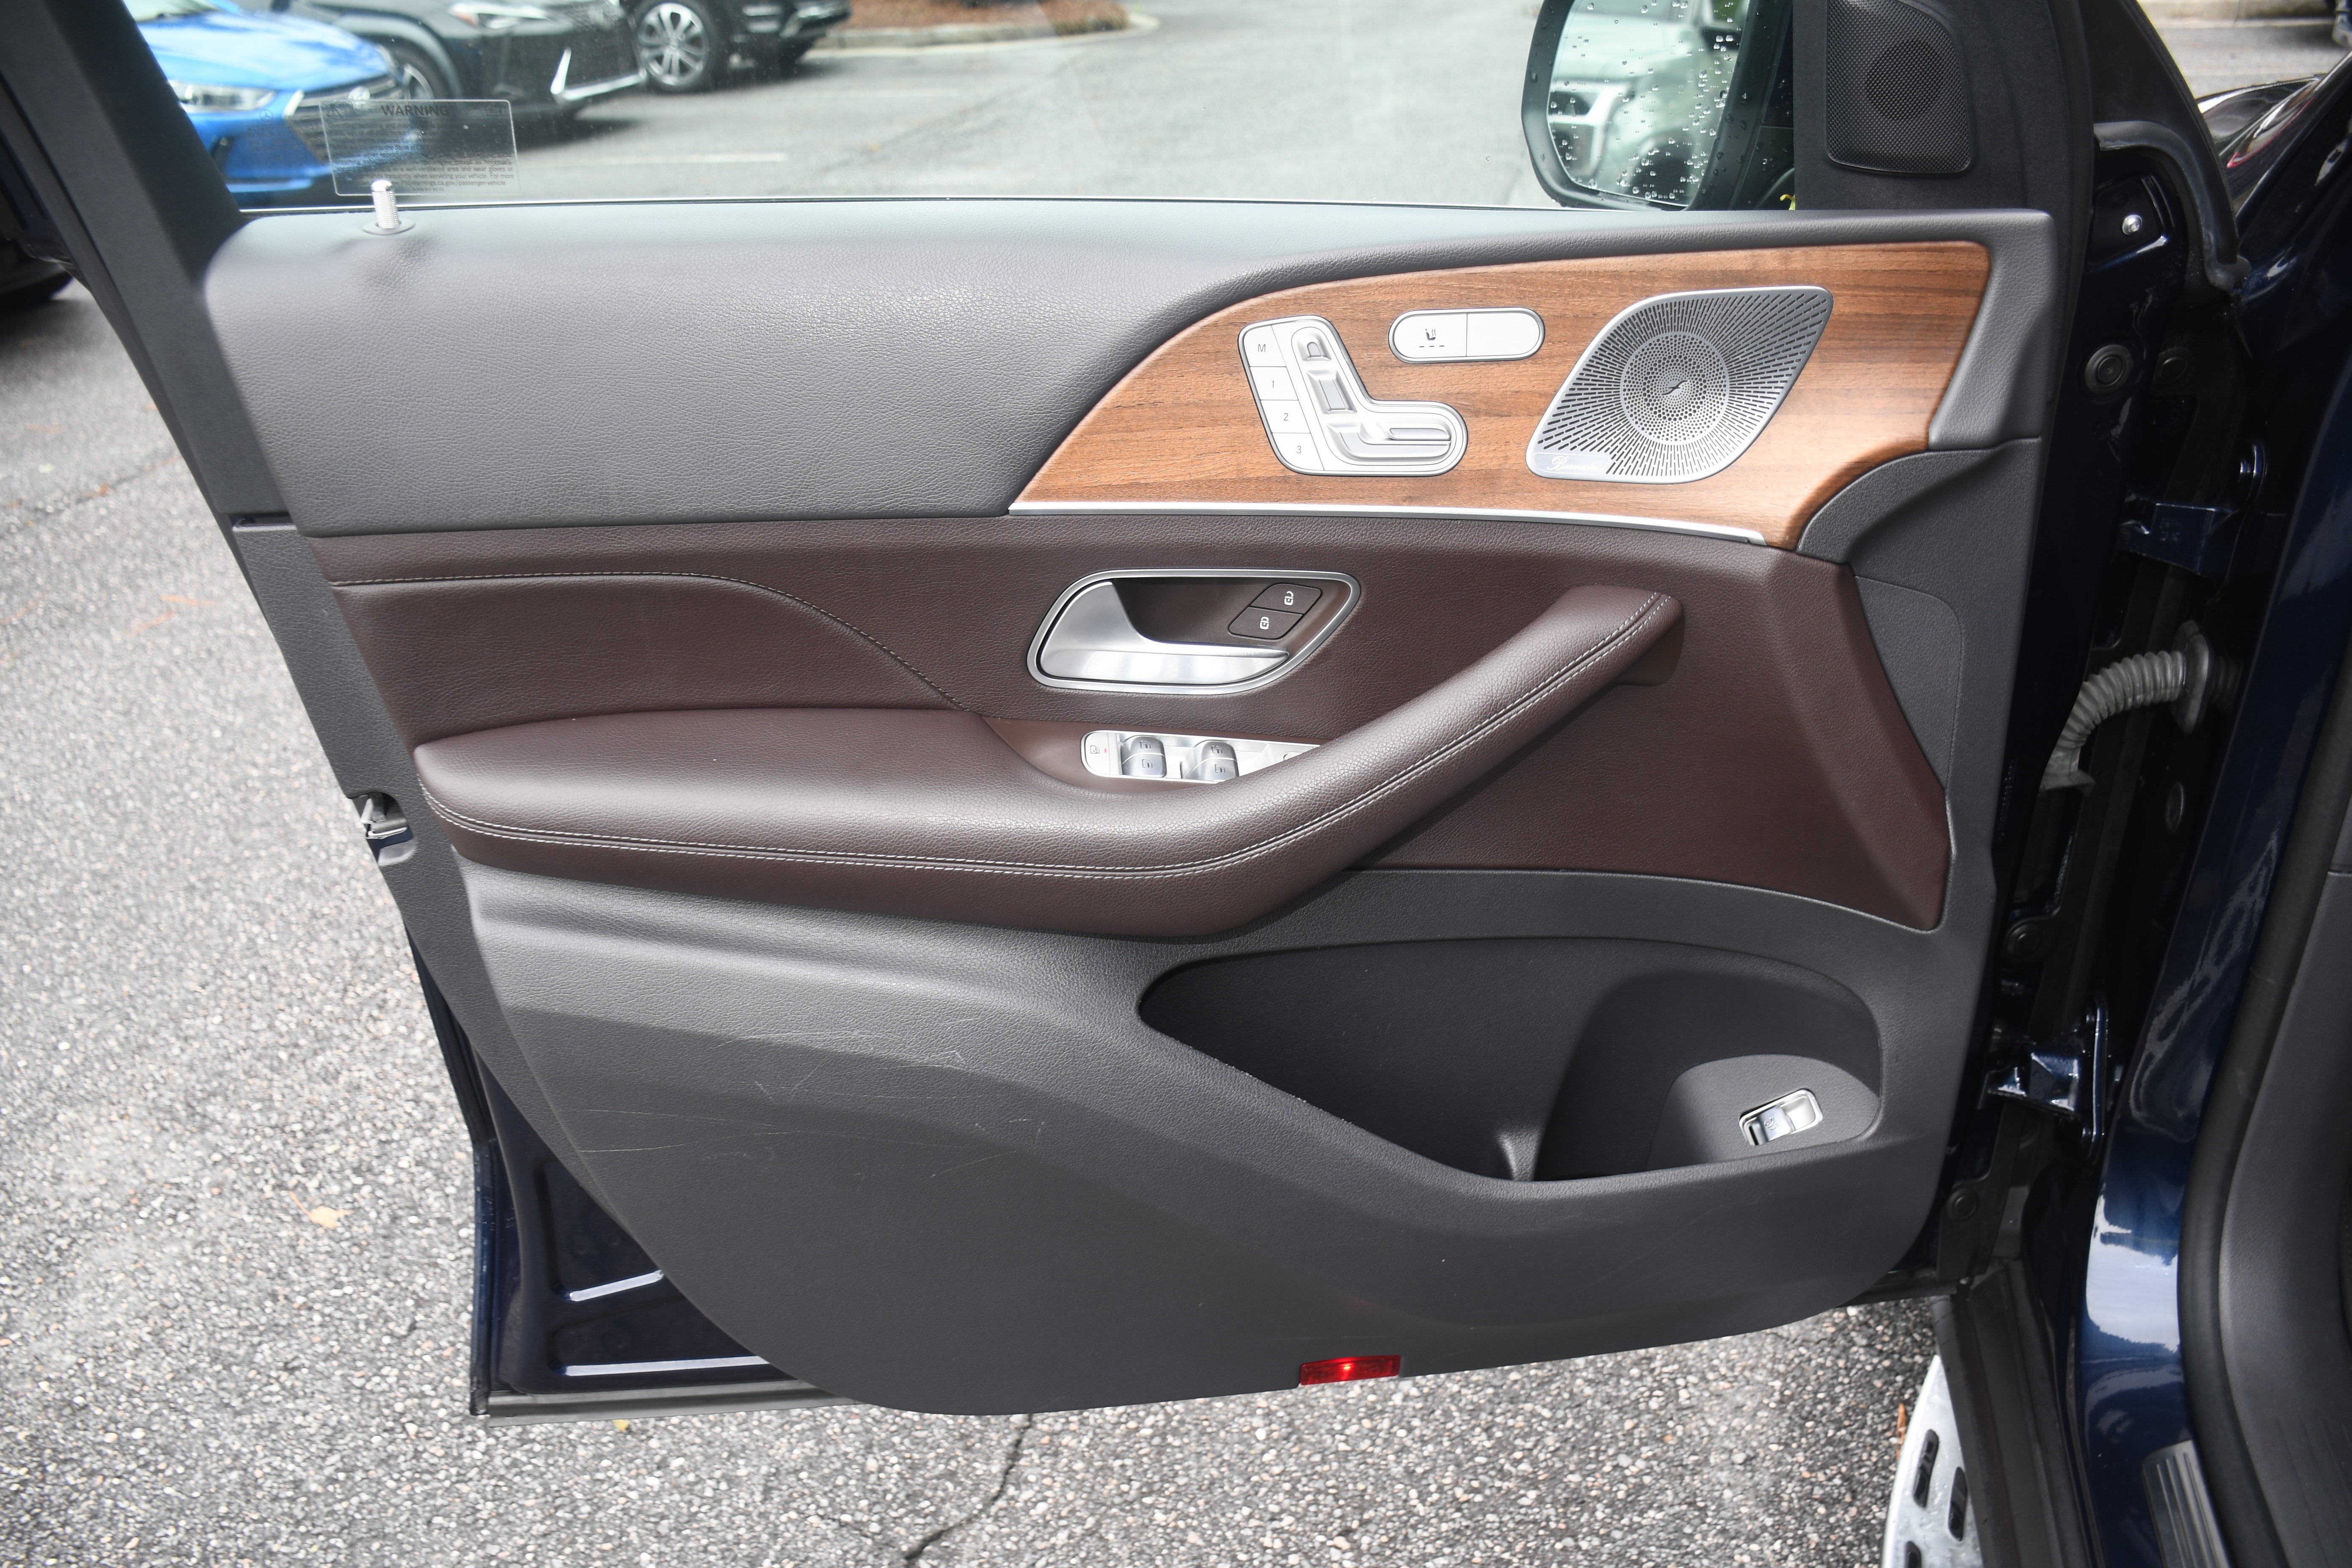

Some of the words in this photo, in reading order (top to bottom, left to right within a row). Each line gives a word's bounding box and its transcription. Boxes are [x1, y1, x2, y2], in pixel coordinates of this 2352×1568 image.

[381, 105, 449, 116] WARNING
[1258, 344, 1266, 352] M
[1271, 380, 1274, 388] 1
[1283, 413, 1288, 421] 2
[1296, 446, 1301, 454] 3
